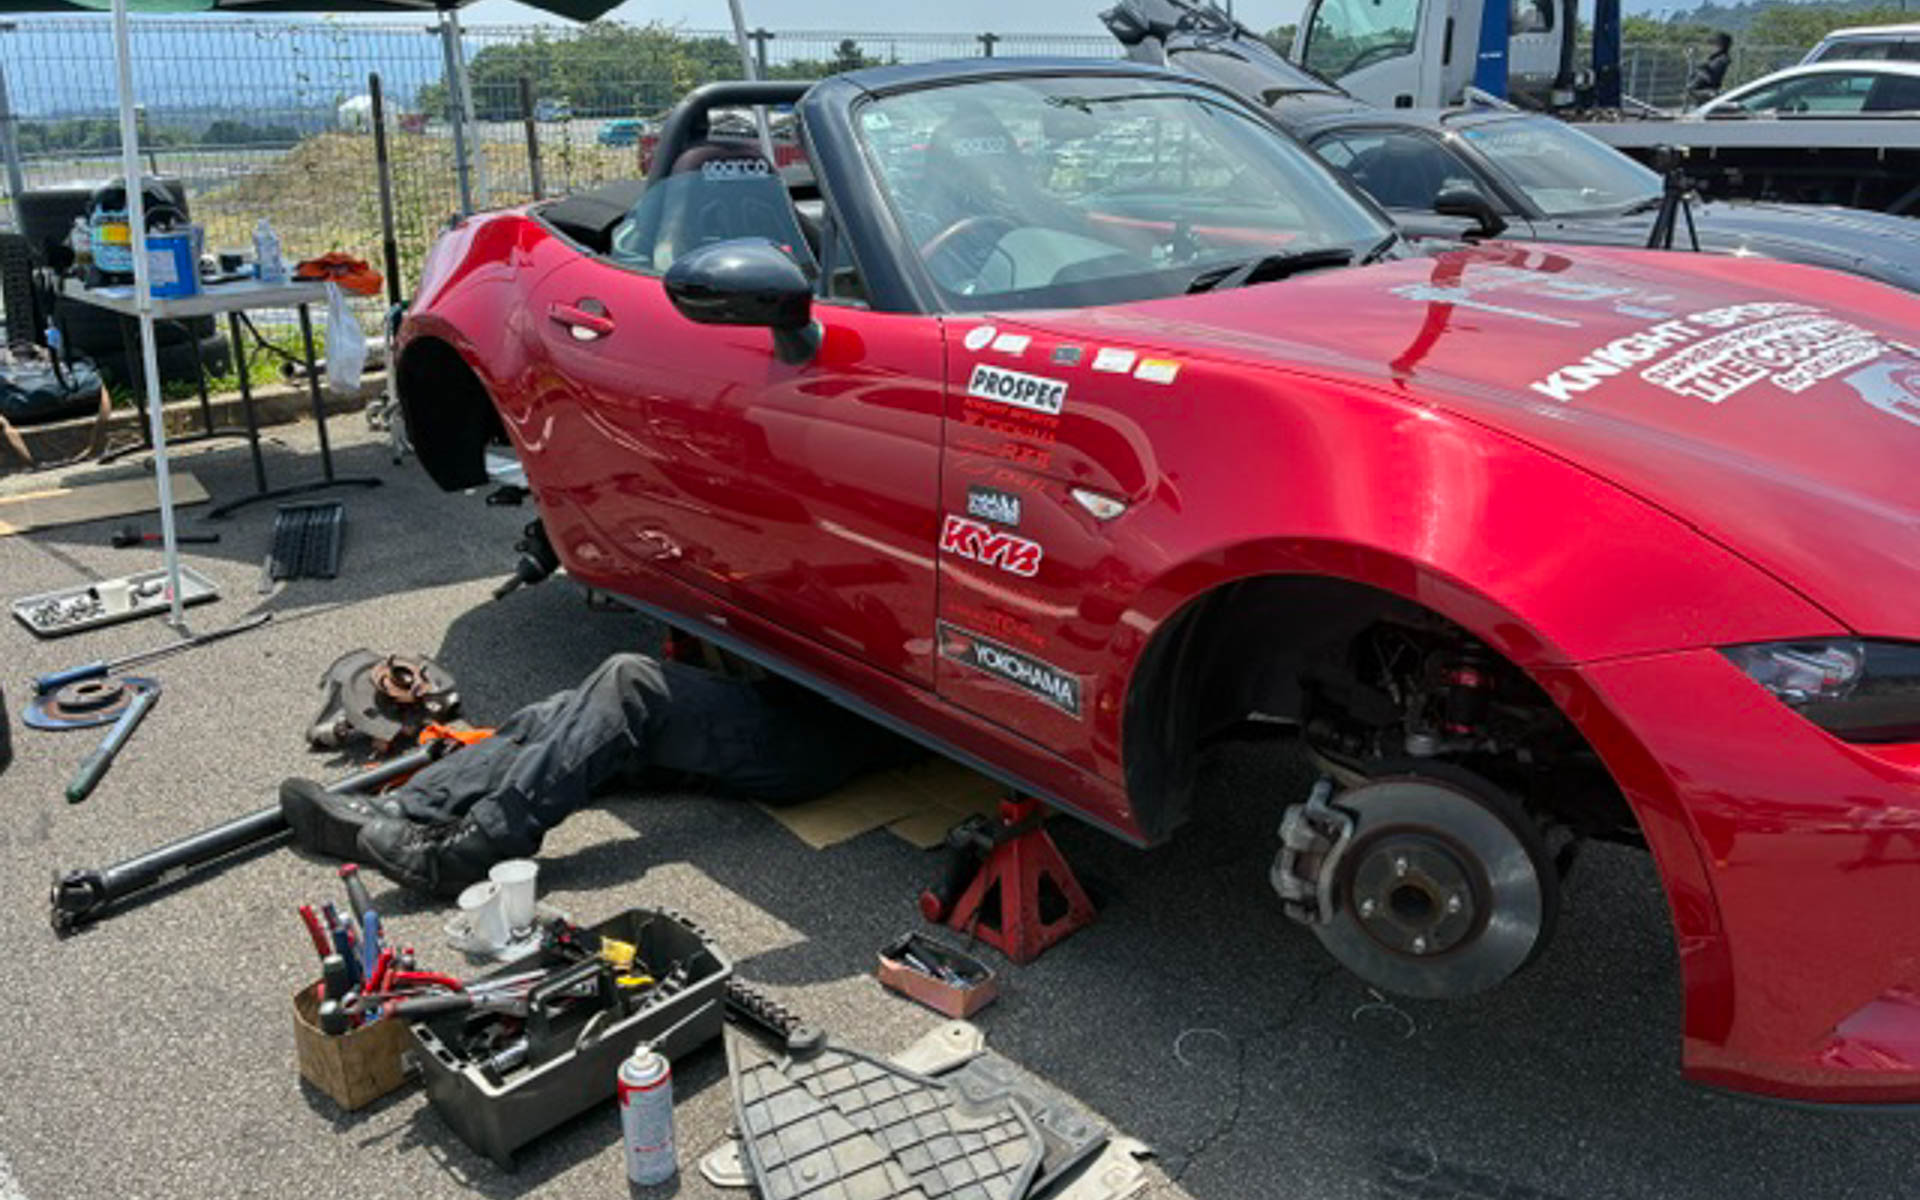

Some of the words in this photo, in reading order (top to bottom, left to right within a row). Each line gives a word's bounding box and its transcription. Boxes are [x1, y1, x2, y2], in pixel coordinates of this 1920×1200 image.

[973, 367, 1064, 409] PROSPEC
[1529, 319, 1702, 401] KNIGHT
[1674, 356, 1769, 400] THE
[941, 515, 1042, 575] KYB
[973, 643, 1075, 708] YOKOHAMA
